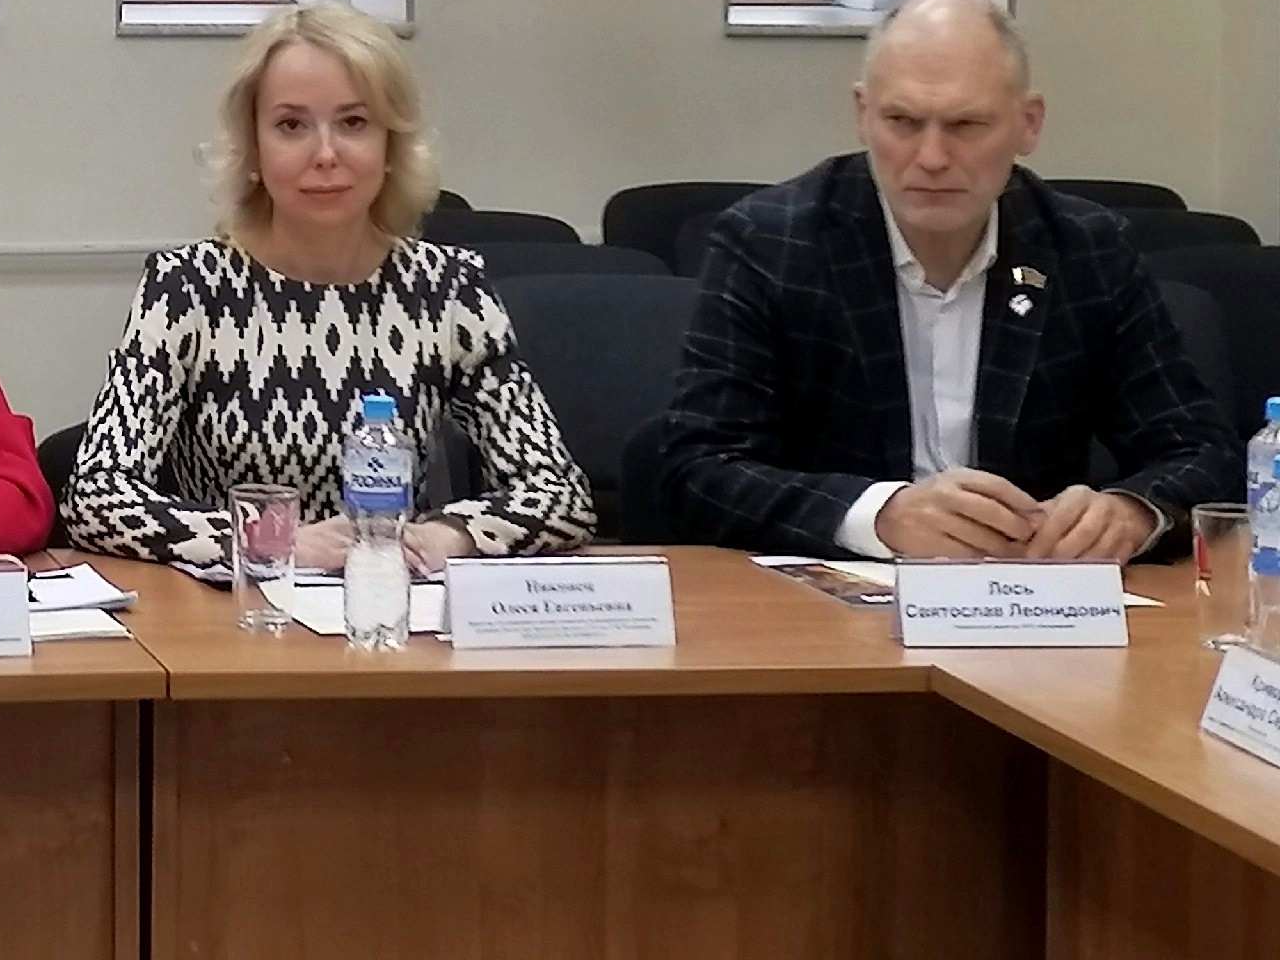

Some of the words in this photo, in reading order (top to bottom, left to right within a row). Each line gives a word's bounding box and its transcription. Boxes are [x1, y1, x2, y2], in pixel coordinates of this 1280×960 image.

[988, 580, 1035, 595] Лось
[905, 604, 1004, 619] Святослав
[1009, 603, 1120, 619] Леонидович
